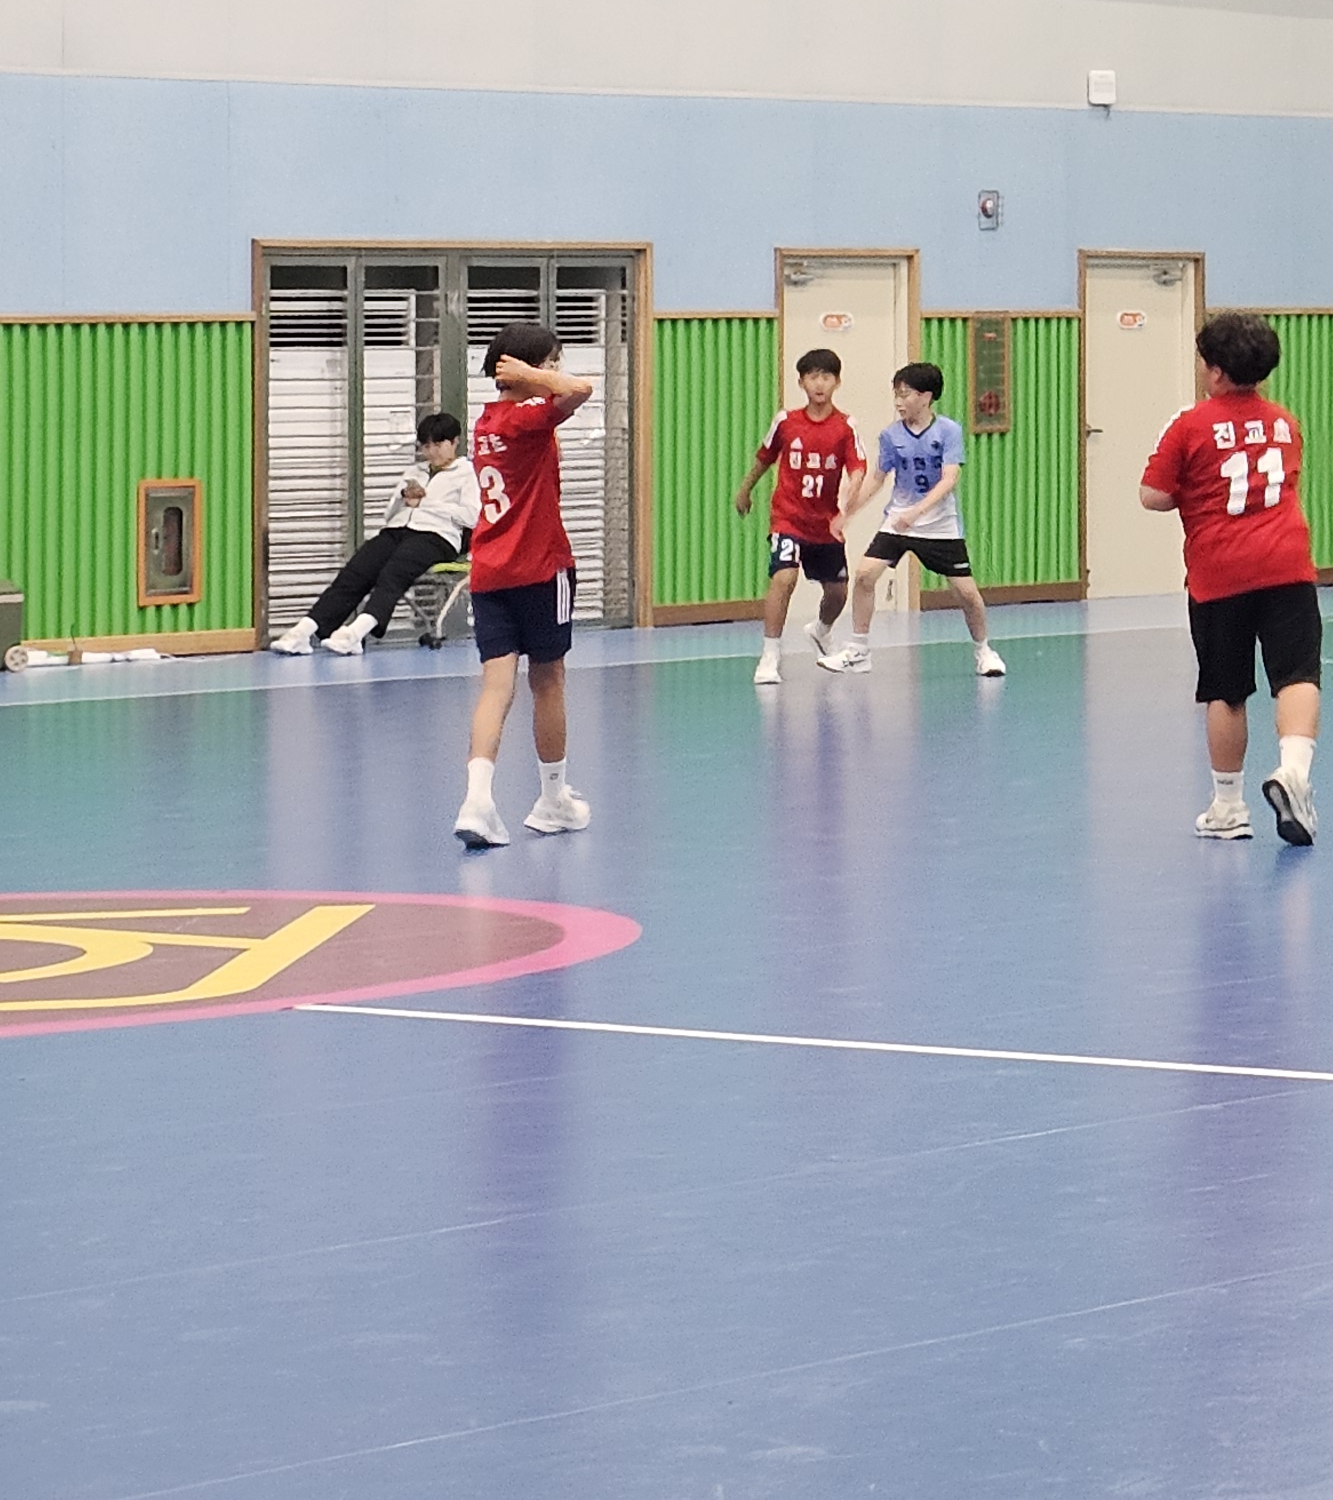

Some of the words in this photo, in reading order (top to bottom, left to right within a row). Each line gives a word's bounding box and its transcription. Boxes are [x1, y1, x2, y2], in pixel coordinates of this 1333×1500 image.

[480, 466, 511, 525] 3
[801, 474, 825, 498] 21
[915, 474, 930, 494] 9
[1220, 447, 1286, 516] 11
